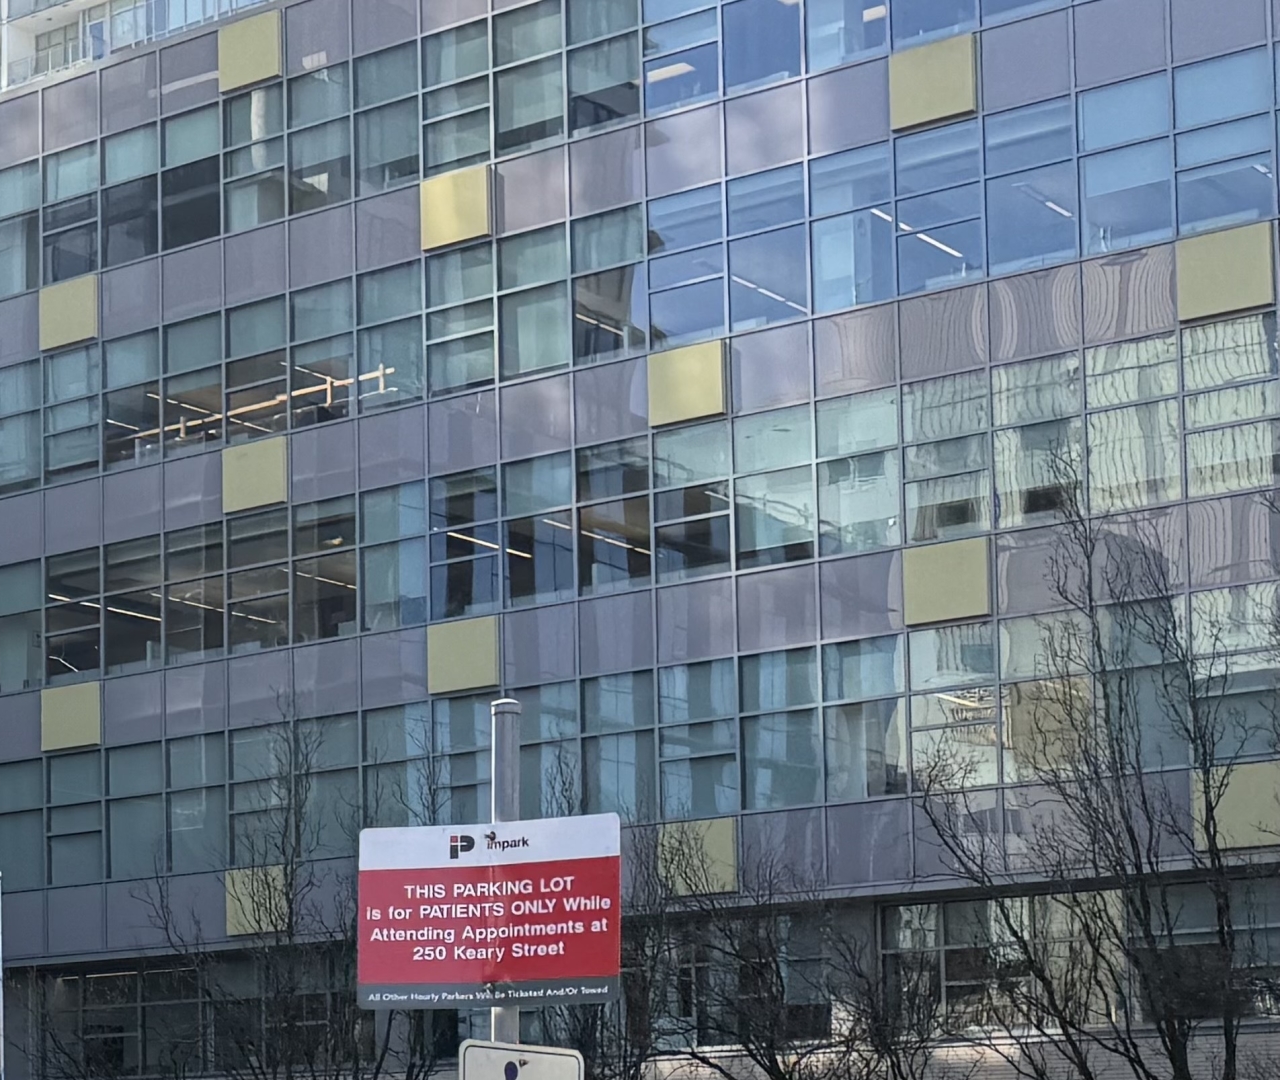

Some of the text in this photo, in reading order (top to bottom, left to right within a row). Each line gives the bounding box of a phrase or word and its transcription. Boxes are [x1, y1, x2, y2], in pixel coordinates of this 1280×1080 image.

[403, 876, 575, 899] THIS PARKING LOT
[366, 896, 611, 920] is for PATIENTS ONLY While
[370, 918, 608, 943] Attending Appointments at
[413, 941, 565, 963] 250 Keary Street
[368, 993, 380, 1001] All
[382, 993, 408, 1001] Other
